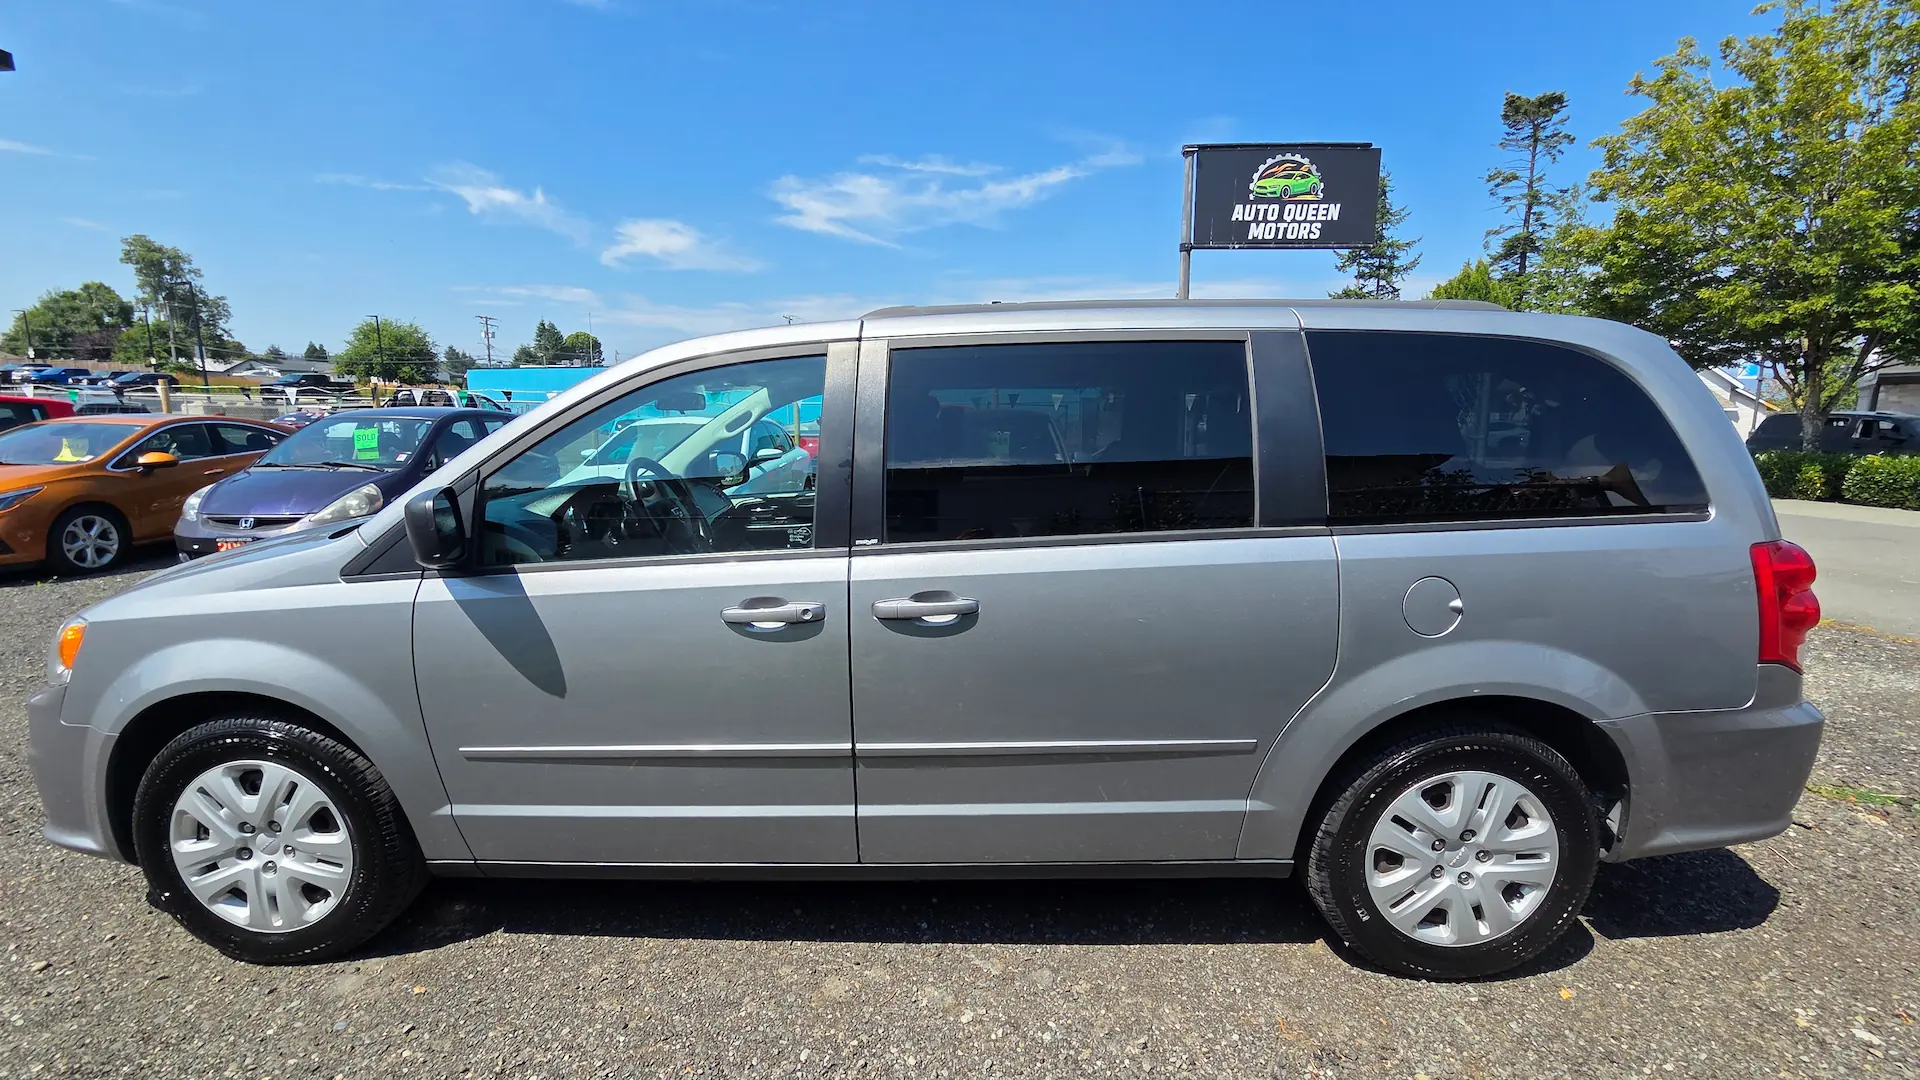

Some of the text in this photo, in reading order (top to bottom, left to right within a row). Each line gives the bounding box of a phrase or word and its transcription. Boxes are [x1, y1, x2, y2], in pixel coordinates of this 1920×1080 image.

[1231, 203, 1341, 222] AUTO QUEEN
[1247, 222, 1322, 240] MOTORS
[356, 433, 376, 441] SOLD
